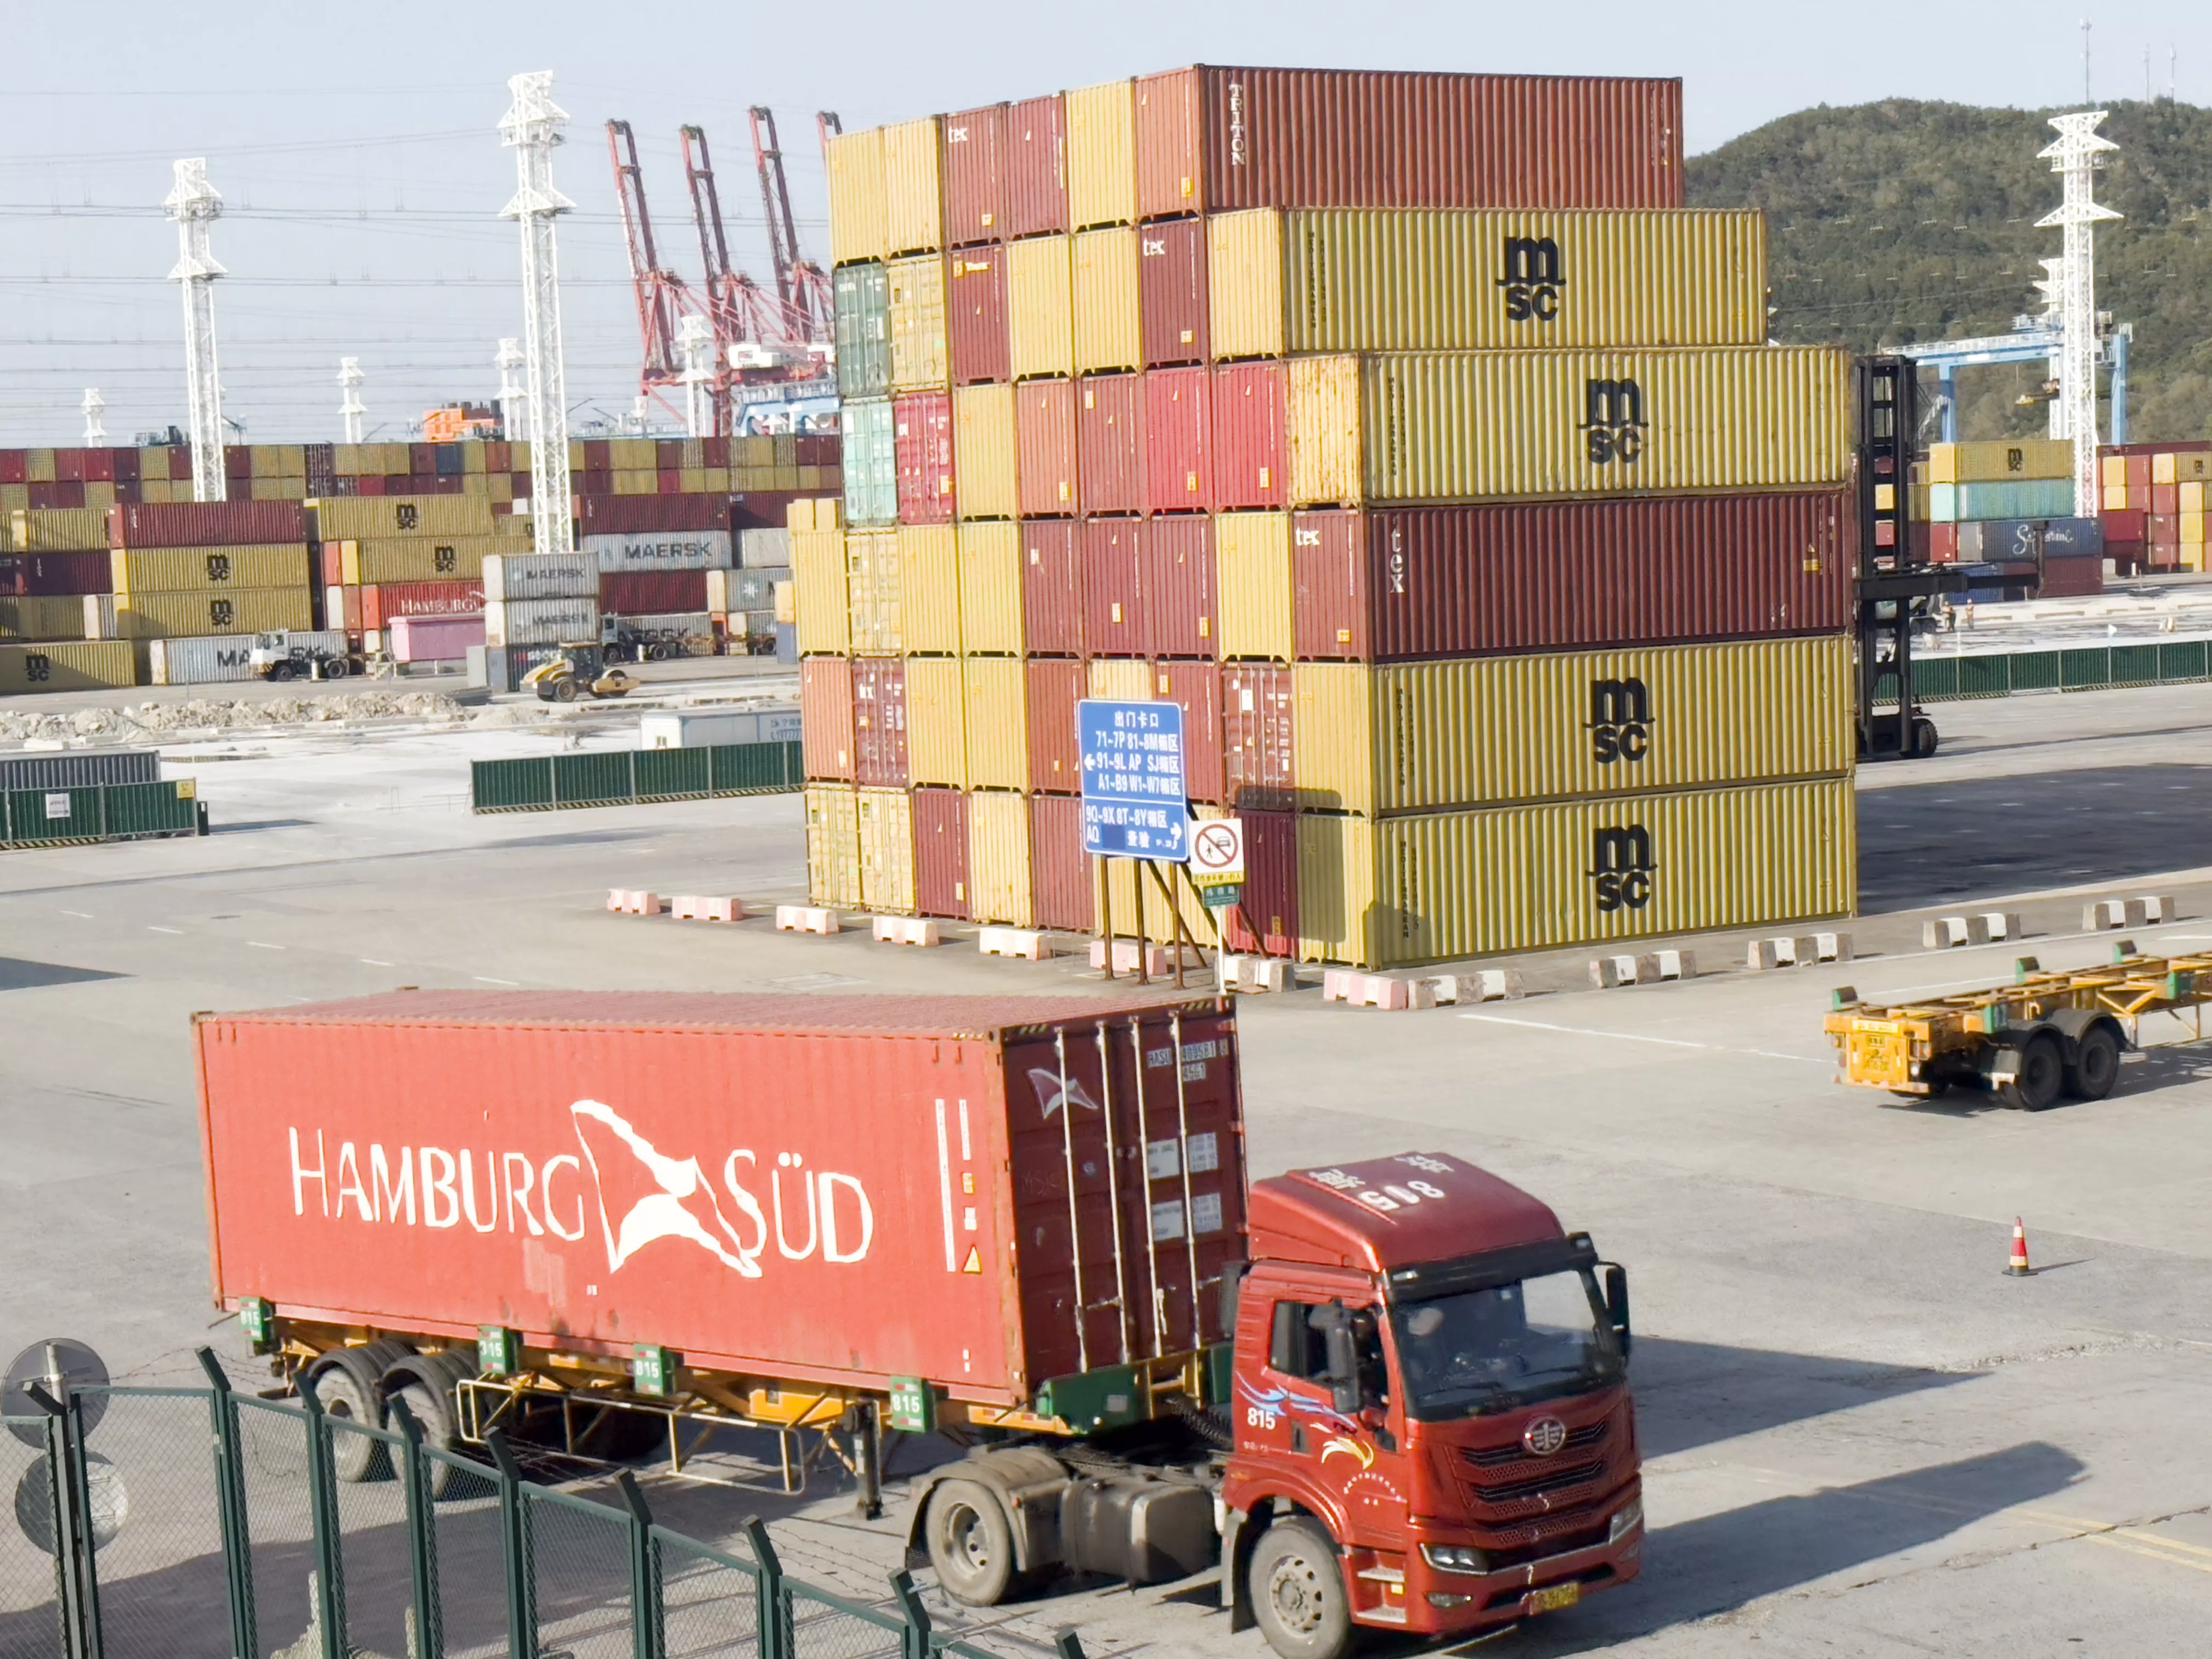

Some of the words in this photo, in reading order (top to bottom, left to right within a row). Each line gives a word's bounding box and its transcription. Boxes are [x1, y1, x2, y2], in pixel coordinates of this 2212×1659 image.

[1228, 84, 1245, 165] TRITON
[625, 541, 712, 559] MAERSK
[1390, 528, 1405, 593] tex
[527, 568, 584, 580] MAERSK
[1115, 710, 1159, 729] 出门卡口
[1128, 753, 1141, 771] AP
[289, 1126, 585, 1242] HAMBURG
[724, 1149, 873, 1262] SÜD
[1358, 1181, 1444, 1211] 815
[635, 1360, 659, 1378] 815
[891, 1395, 920, 1413] 815
[1247, 1407, 1276, 1430] 815
